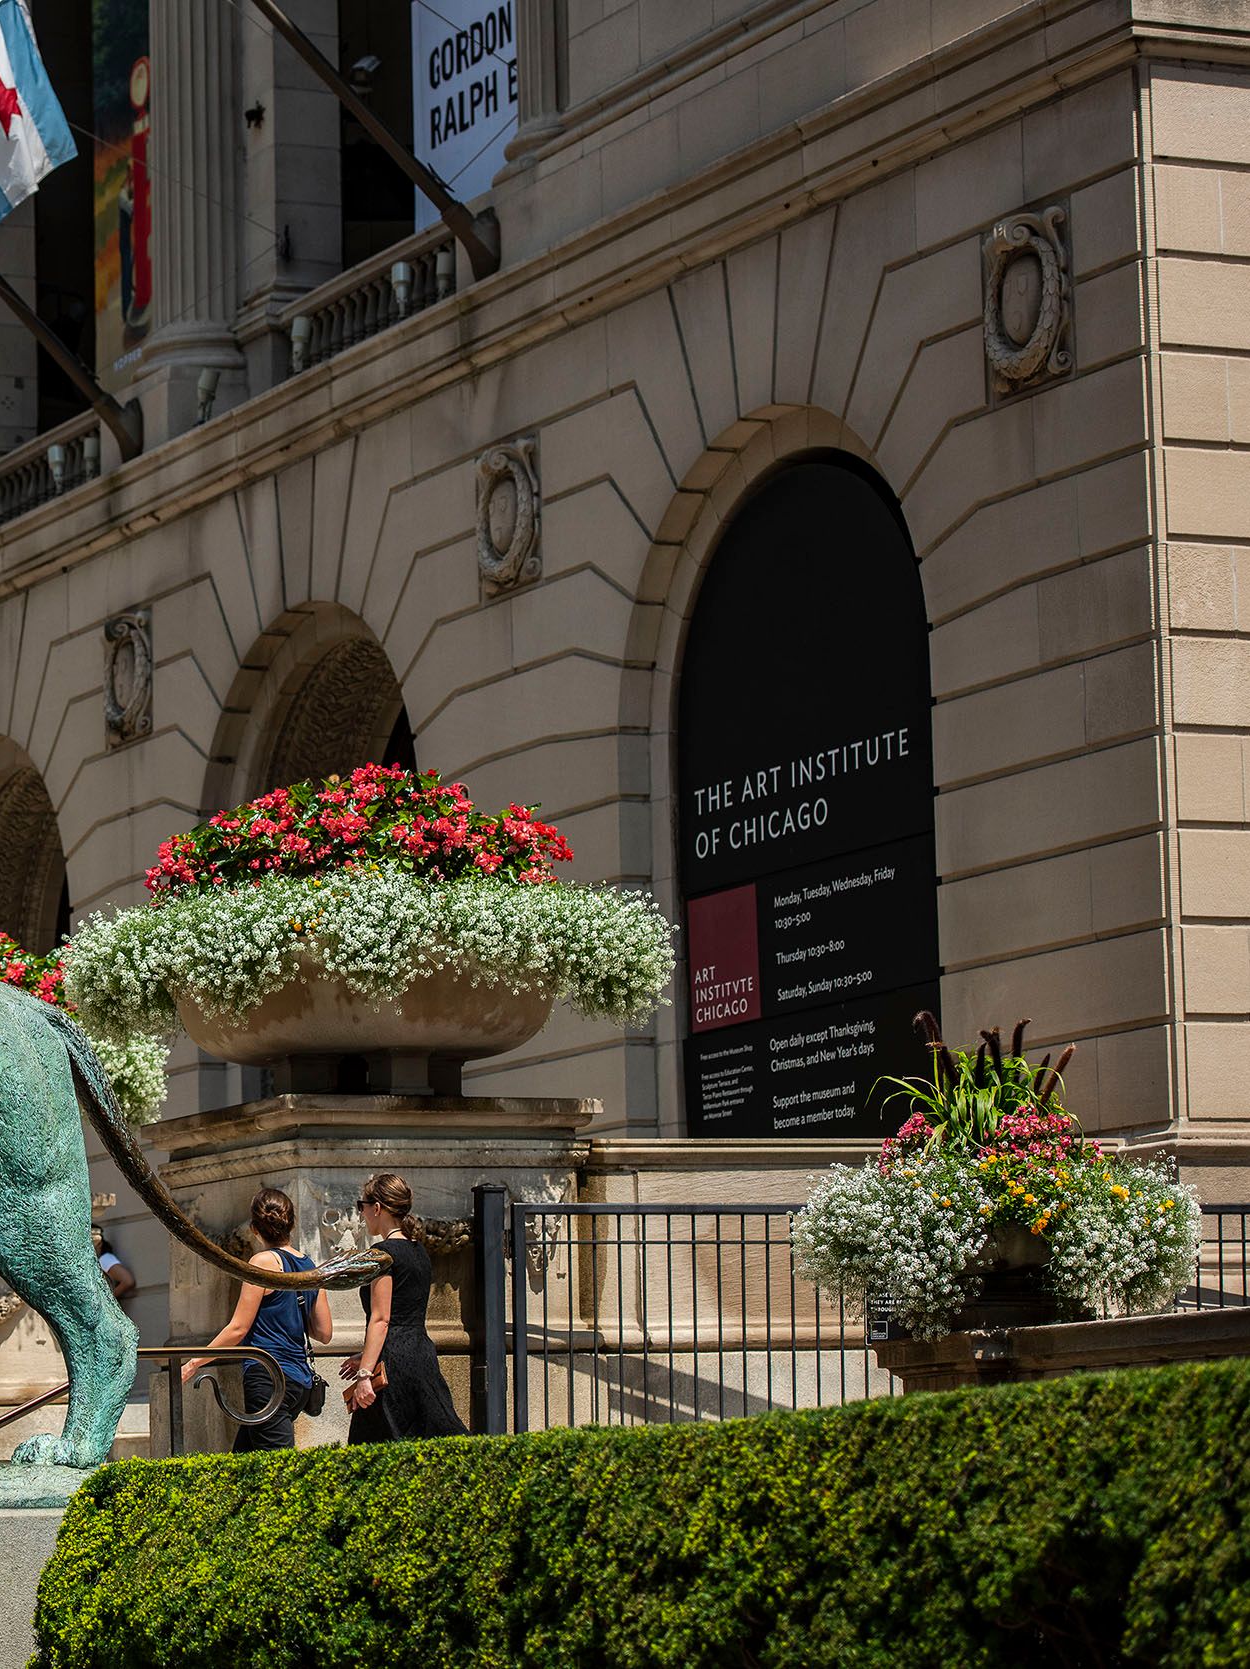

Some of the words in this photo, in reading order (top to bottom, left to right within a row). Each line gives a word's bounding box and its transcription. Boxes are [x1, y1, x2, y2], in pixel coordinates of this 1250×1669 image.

[429, 1, 512, 89] GORDON
[430, 70, 498, 150] RALPH
[694, 780, 733, 816] THE
[741, 766, 781, 803] ART
[791, 728, 909, 788] INSTITUTE
[695, 828, 721, 859] OF
[729, 798, 828, 849] CHICAGO
[774, 892, 802, 908] Monday,
[803, 884, 831, 900] Tuesday,
[832, 873, 873, 893] Wednesday,
[874, 866, 895, 882] Friday
[776, 947, 807, 965] Thursday
[695, 965, 715, 984] ART
[777, 985, 807, 1001] Saturday,
[808, 978, 833, 994] Sunday
[695, 976, 754, 1004] INSTITVTE
[696, 998, 748, 1023] CHICAGO
[770, 1038, 789, 1053] Open
[789, 1032, 805, 1047] daily
[805, 1030, 828, 1043] except
[829, 1020, 876, 1038] Thanksgiving,
[770, 1057, 806, 1072] Christmas,
[806, 1050, 819, 1064] and
[819, 1049, 836, 1062] New
[858, 1041, 875, 1056] days
[772, 1094, 799, 1109] Support
[799, 1090, 811, 1103] the
[812, 1087, 841, 1100] museum
[841, 1080, 855, 1095] and
[773, 1116, 800, 1130] become
[800, 1116, 806, 1125] a
[806, 1108, 834, 1123] member
[835, 1104, 856, 1119] today.
